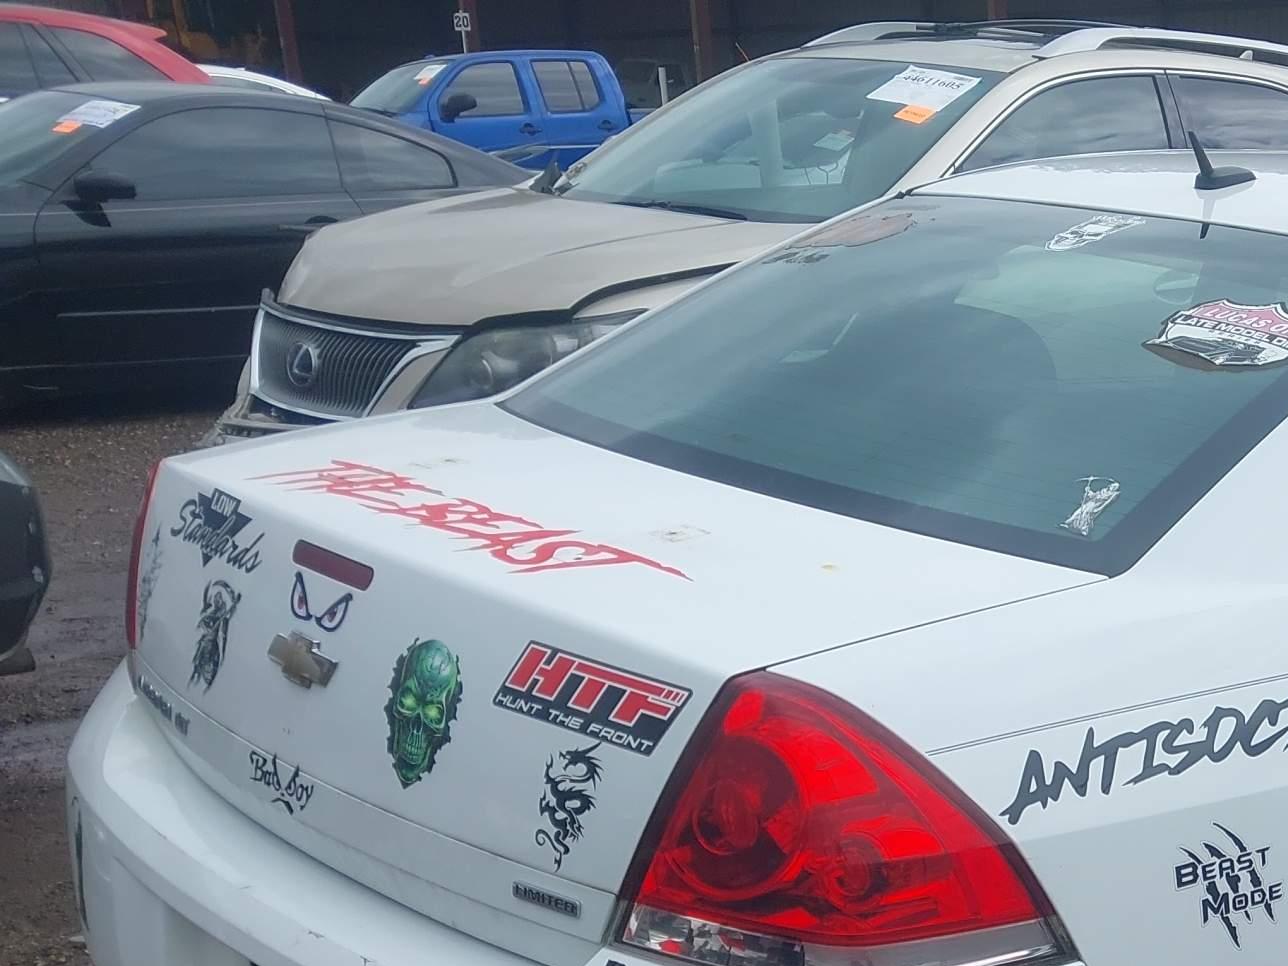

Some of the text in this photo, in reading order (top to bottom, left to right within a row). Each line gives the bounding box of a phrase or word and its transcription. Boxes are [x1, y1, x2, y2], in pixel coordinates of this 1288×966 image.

[454, 15, 469, 28] 20
[1177, 314, 1218, 329] LATE
[1220, 322, 1273, 342] MODEL
[1206, 307, 1273, 329] LUCAS
[211, 491, 238, 517] LOW
[170, 499, 265, 574] Standards
[358, 497, 694, 582] BEAST
[504, 643, 690, 727] HTF
[495, 692, 654, 752] HUNT THE FRONT
[513, 883, 579, 914] LIMITED
